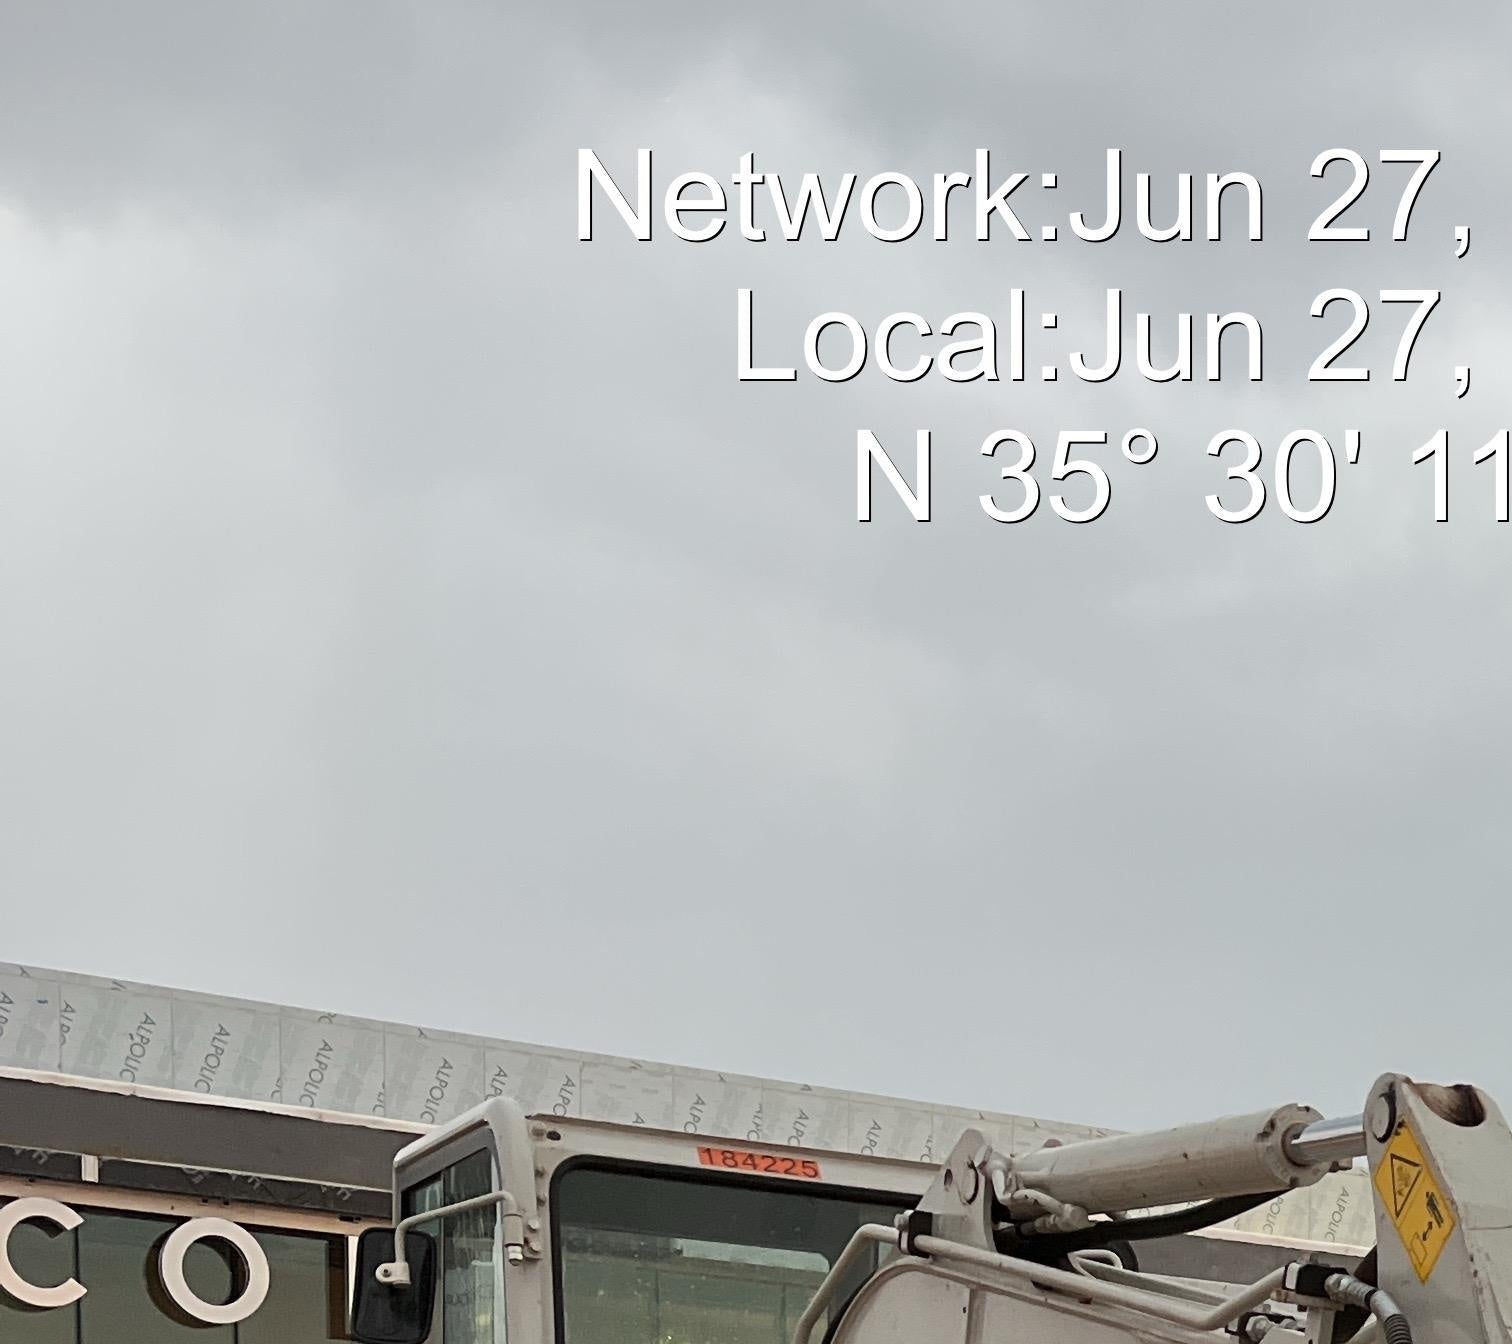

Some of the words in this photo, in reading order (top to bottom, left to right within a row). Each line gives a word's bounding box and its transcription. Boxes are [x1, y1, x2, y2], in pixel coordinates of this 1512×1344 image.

[120, 1012, 157, 1083] ALPOLIC
[194, 1023, 232, 1095] ALPOLIC
[299, 1039, 334, 1108] ALPOLIC
[420, 1057, 454, 1124] ALPOLIC
[701, 1148, 820, 1178] 184225
[1324, 1186, 1351, 1243] ALPOLIC
